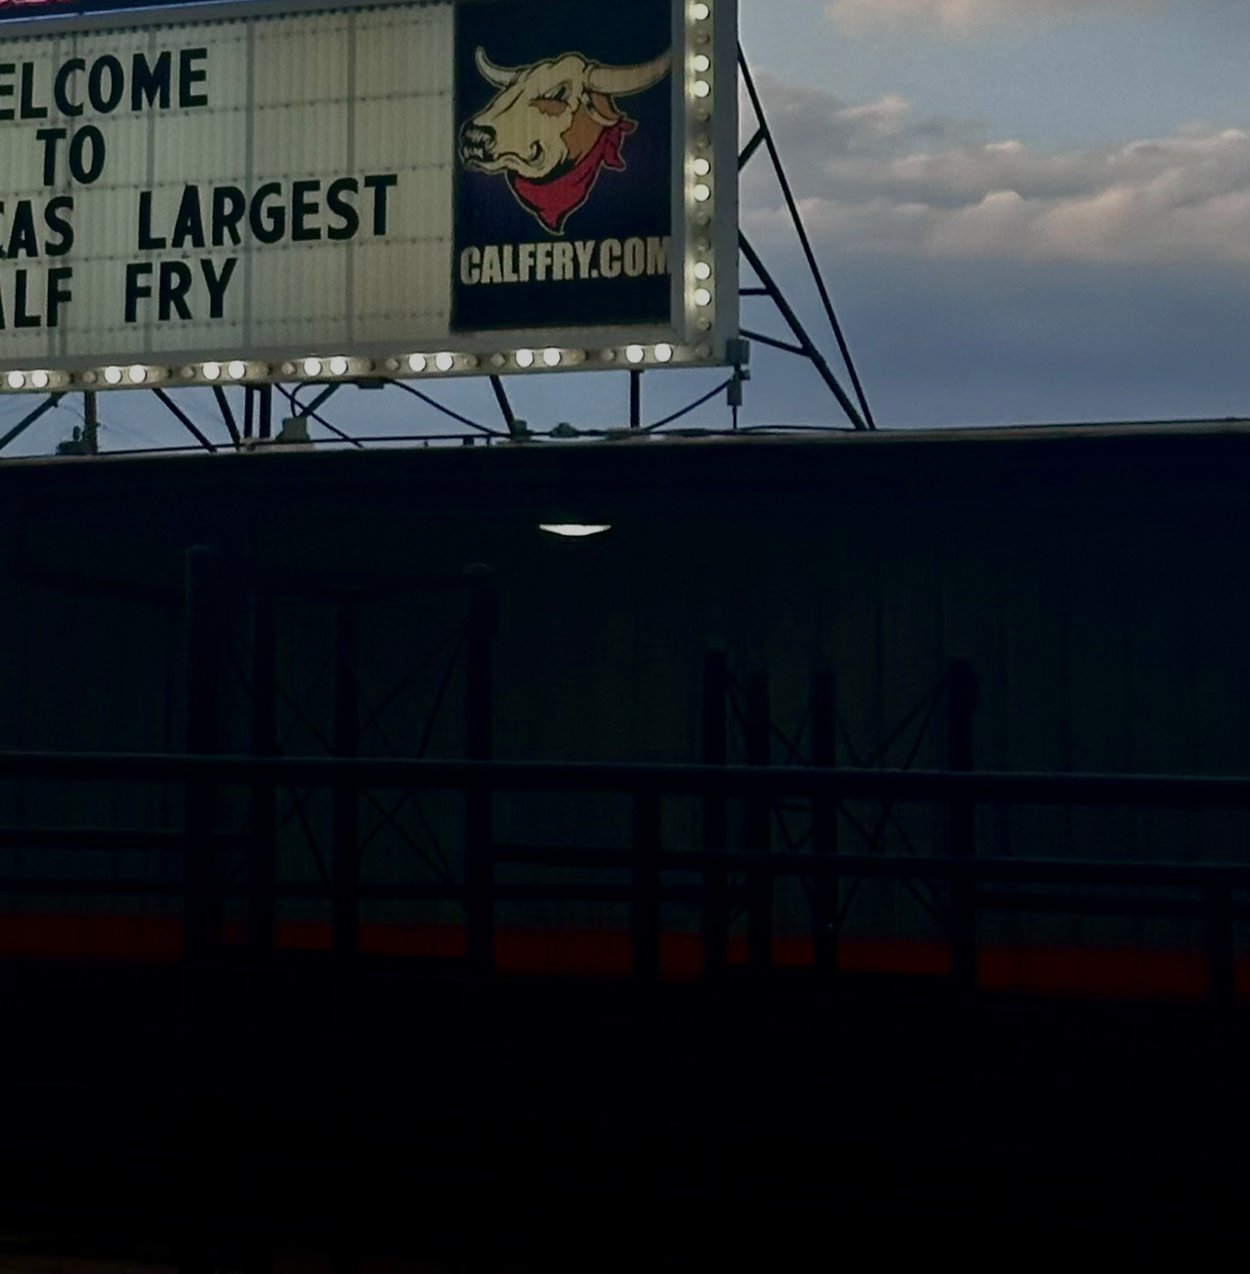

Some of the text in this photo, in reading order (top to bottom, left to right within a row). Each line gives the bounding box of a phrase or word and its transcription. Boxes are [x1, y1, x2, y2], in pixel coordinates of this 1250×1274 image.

[36, 124, 106, 186] TO
[138, 174, 398, 250] LARGEST
[124, 257, 238, 323] FRY
[460, 235, 672, 285] CALFFRY.COM
